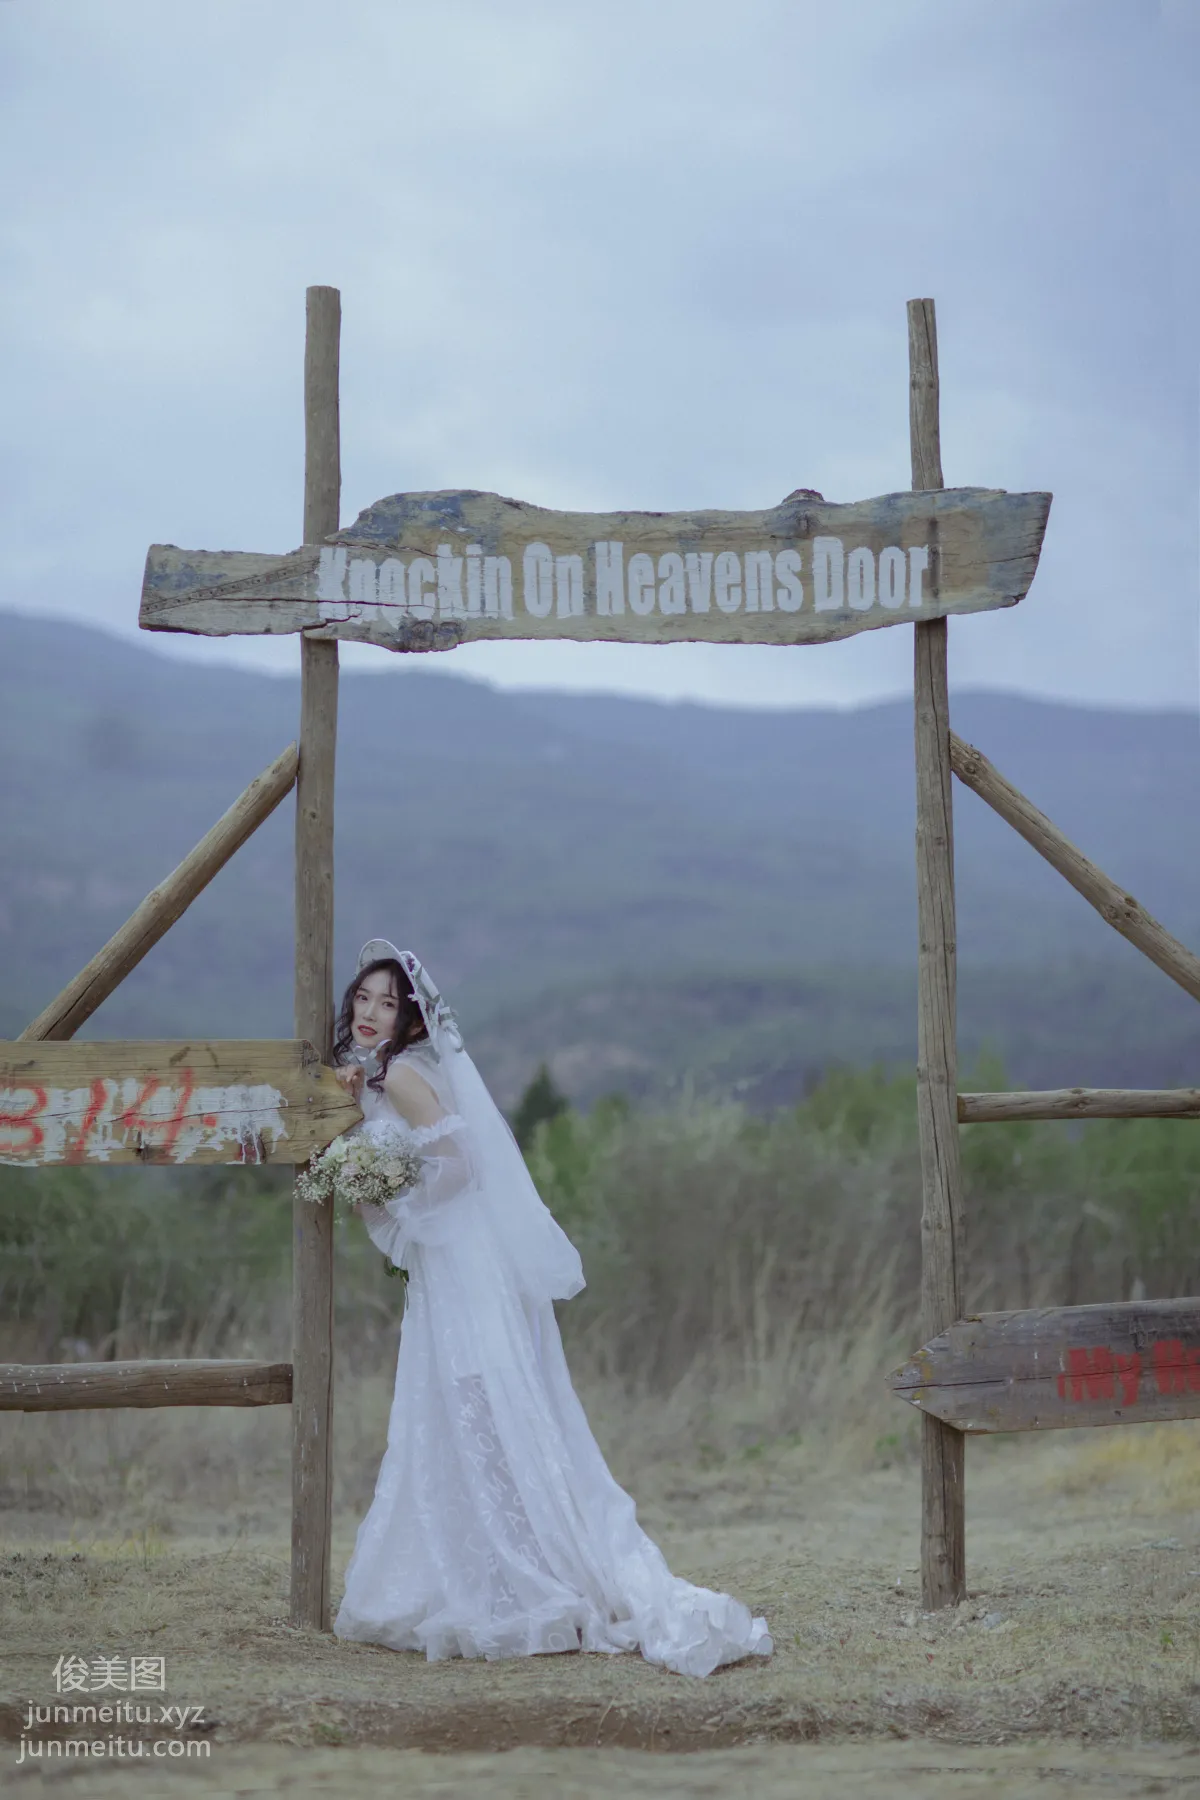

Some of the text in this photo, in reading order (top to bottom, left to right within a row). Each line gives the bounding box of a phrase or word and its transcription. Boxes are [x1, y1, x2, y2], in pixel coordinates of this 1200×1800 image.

[316, 535, 930, 630] Knockin On Heavens Door
